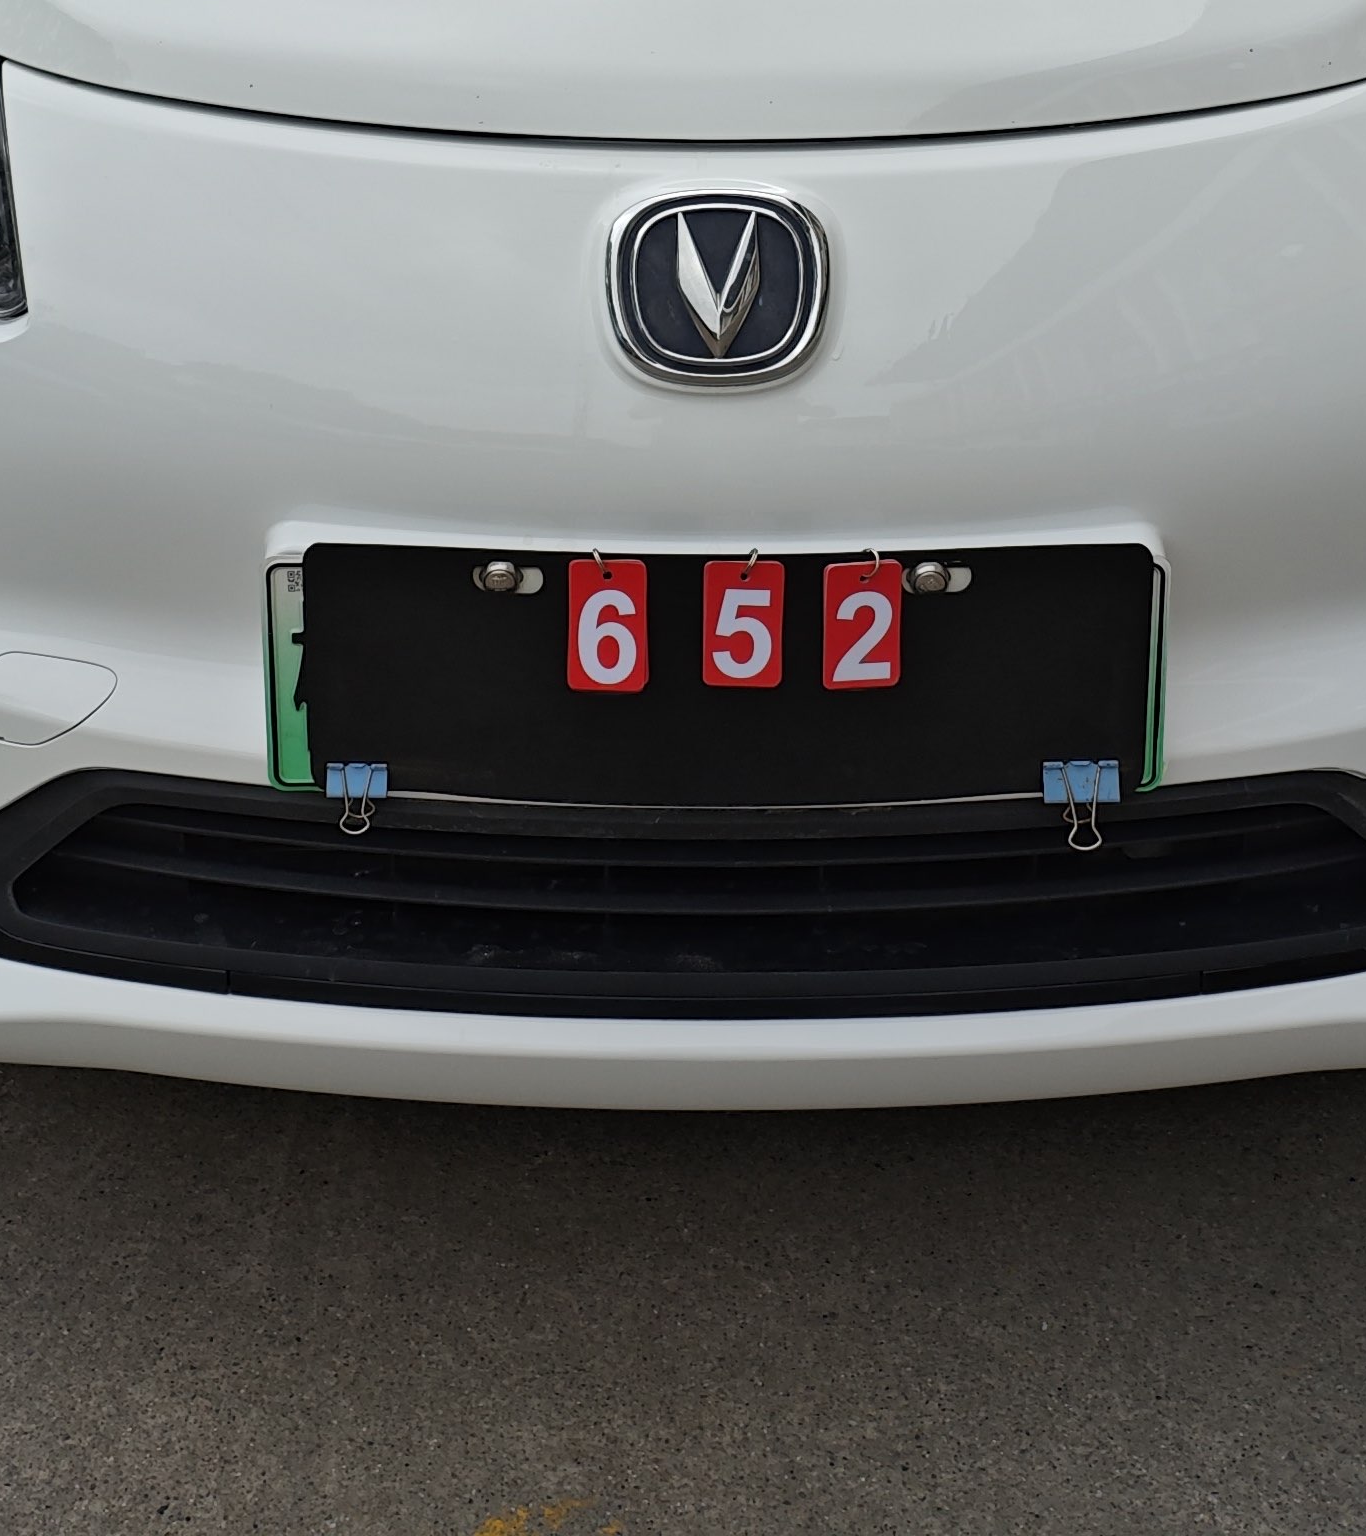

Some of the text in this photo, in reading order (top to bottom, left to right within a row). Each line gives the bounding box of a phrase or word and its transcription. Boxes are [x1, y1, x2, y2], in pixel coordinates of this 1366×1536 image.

[577, 588, 894, 685] 6 5 2
